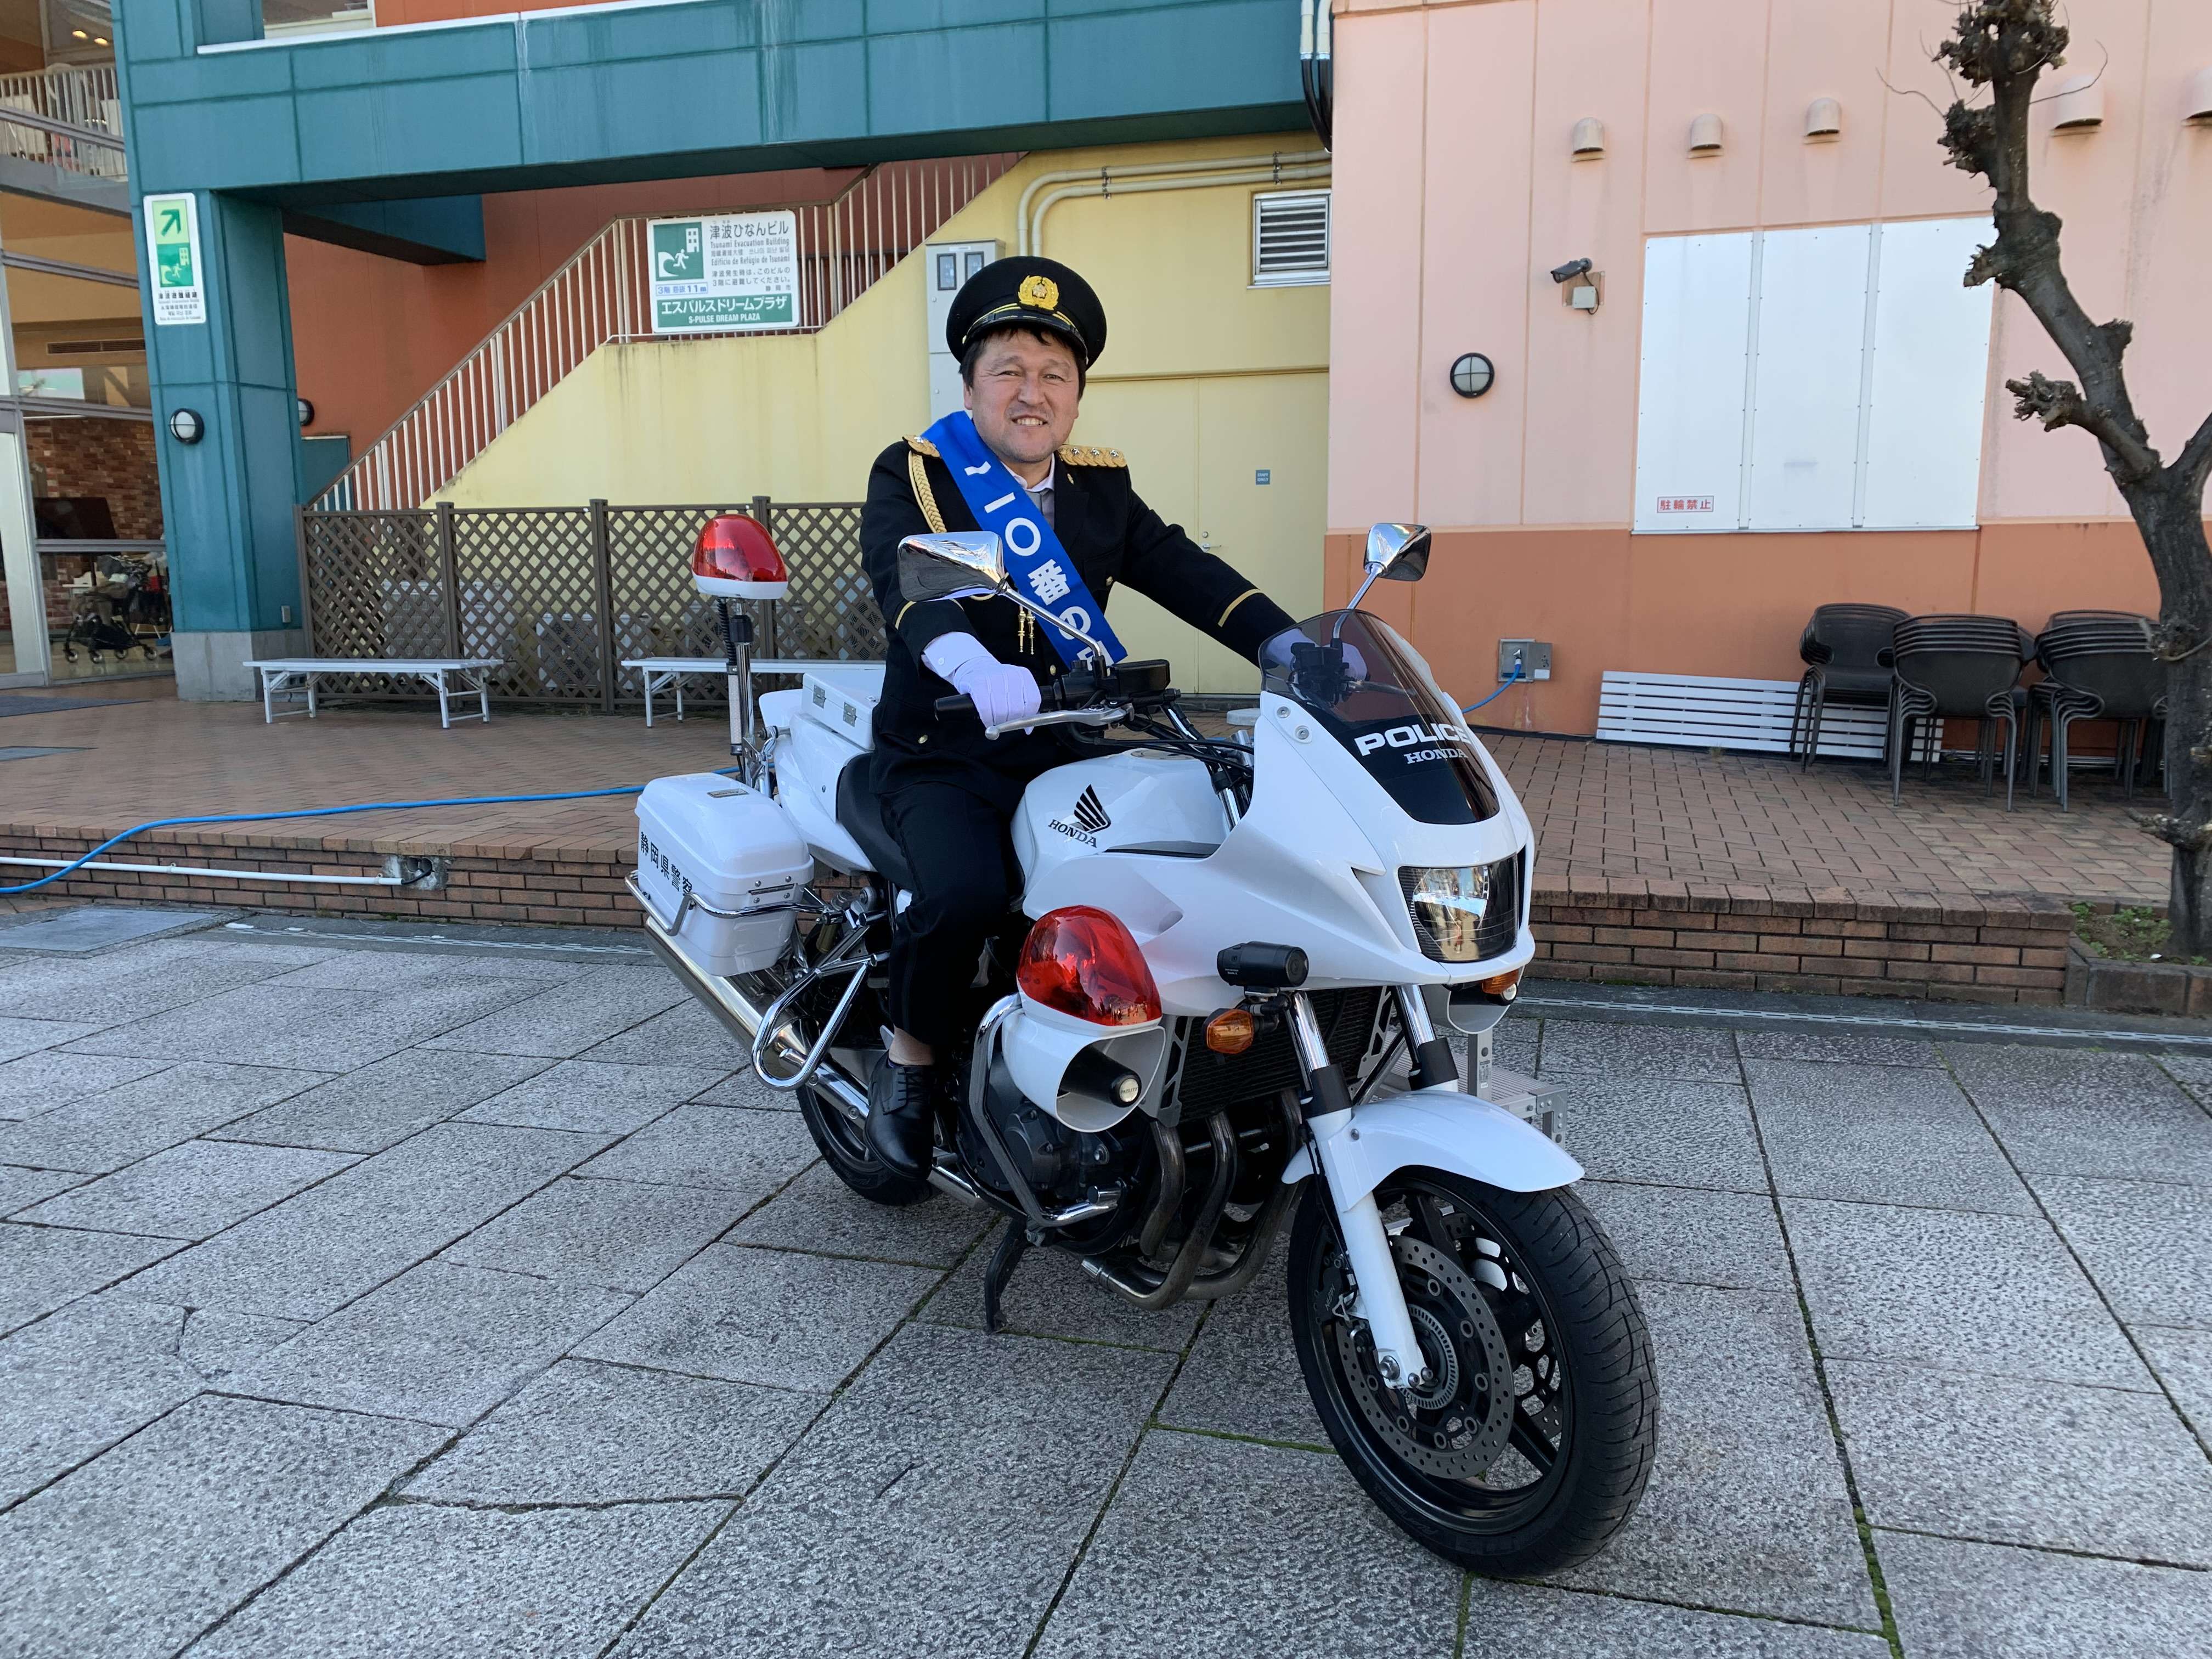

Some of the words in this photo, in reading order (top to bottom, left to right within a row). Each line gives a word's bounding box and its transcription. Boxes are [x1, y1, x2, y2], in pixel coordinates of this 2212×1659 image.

[709, 221, 789, 240] 津波ひなんビル
[710, 240, 732, 249] Tsunami
[735, 238, 764, 247] Evacuation
[766, 238, 790, 246] Building
[769, 254, 790, 263] Tsunami
[661, 295, 788, 315] エスパルスドリームプラザ
[689, 315, 714, 324] S-PULSE
[716, 313, 739, 323] DREAM
[741, 313, 761, 321] PLAZA
[1660, 499, 1711, 511] 駐輪禁止
[1353, 723, 1472, 757] POLICE
[1403, 748, 1468, 764] HONDA
[1047, 819, 1098, 849] HONDA
[640, 831, 692, 896] 静岡県警察
